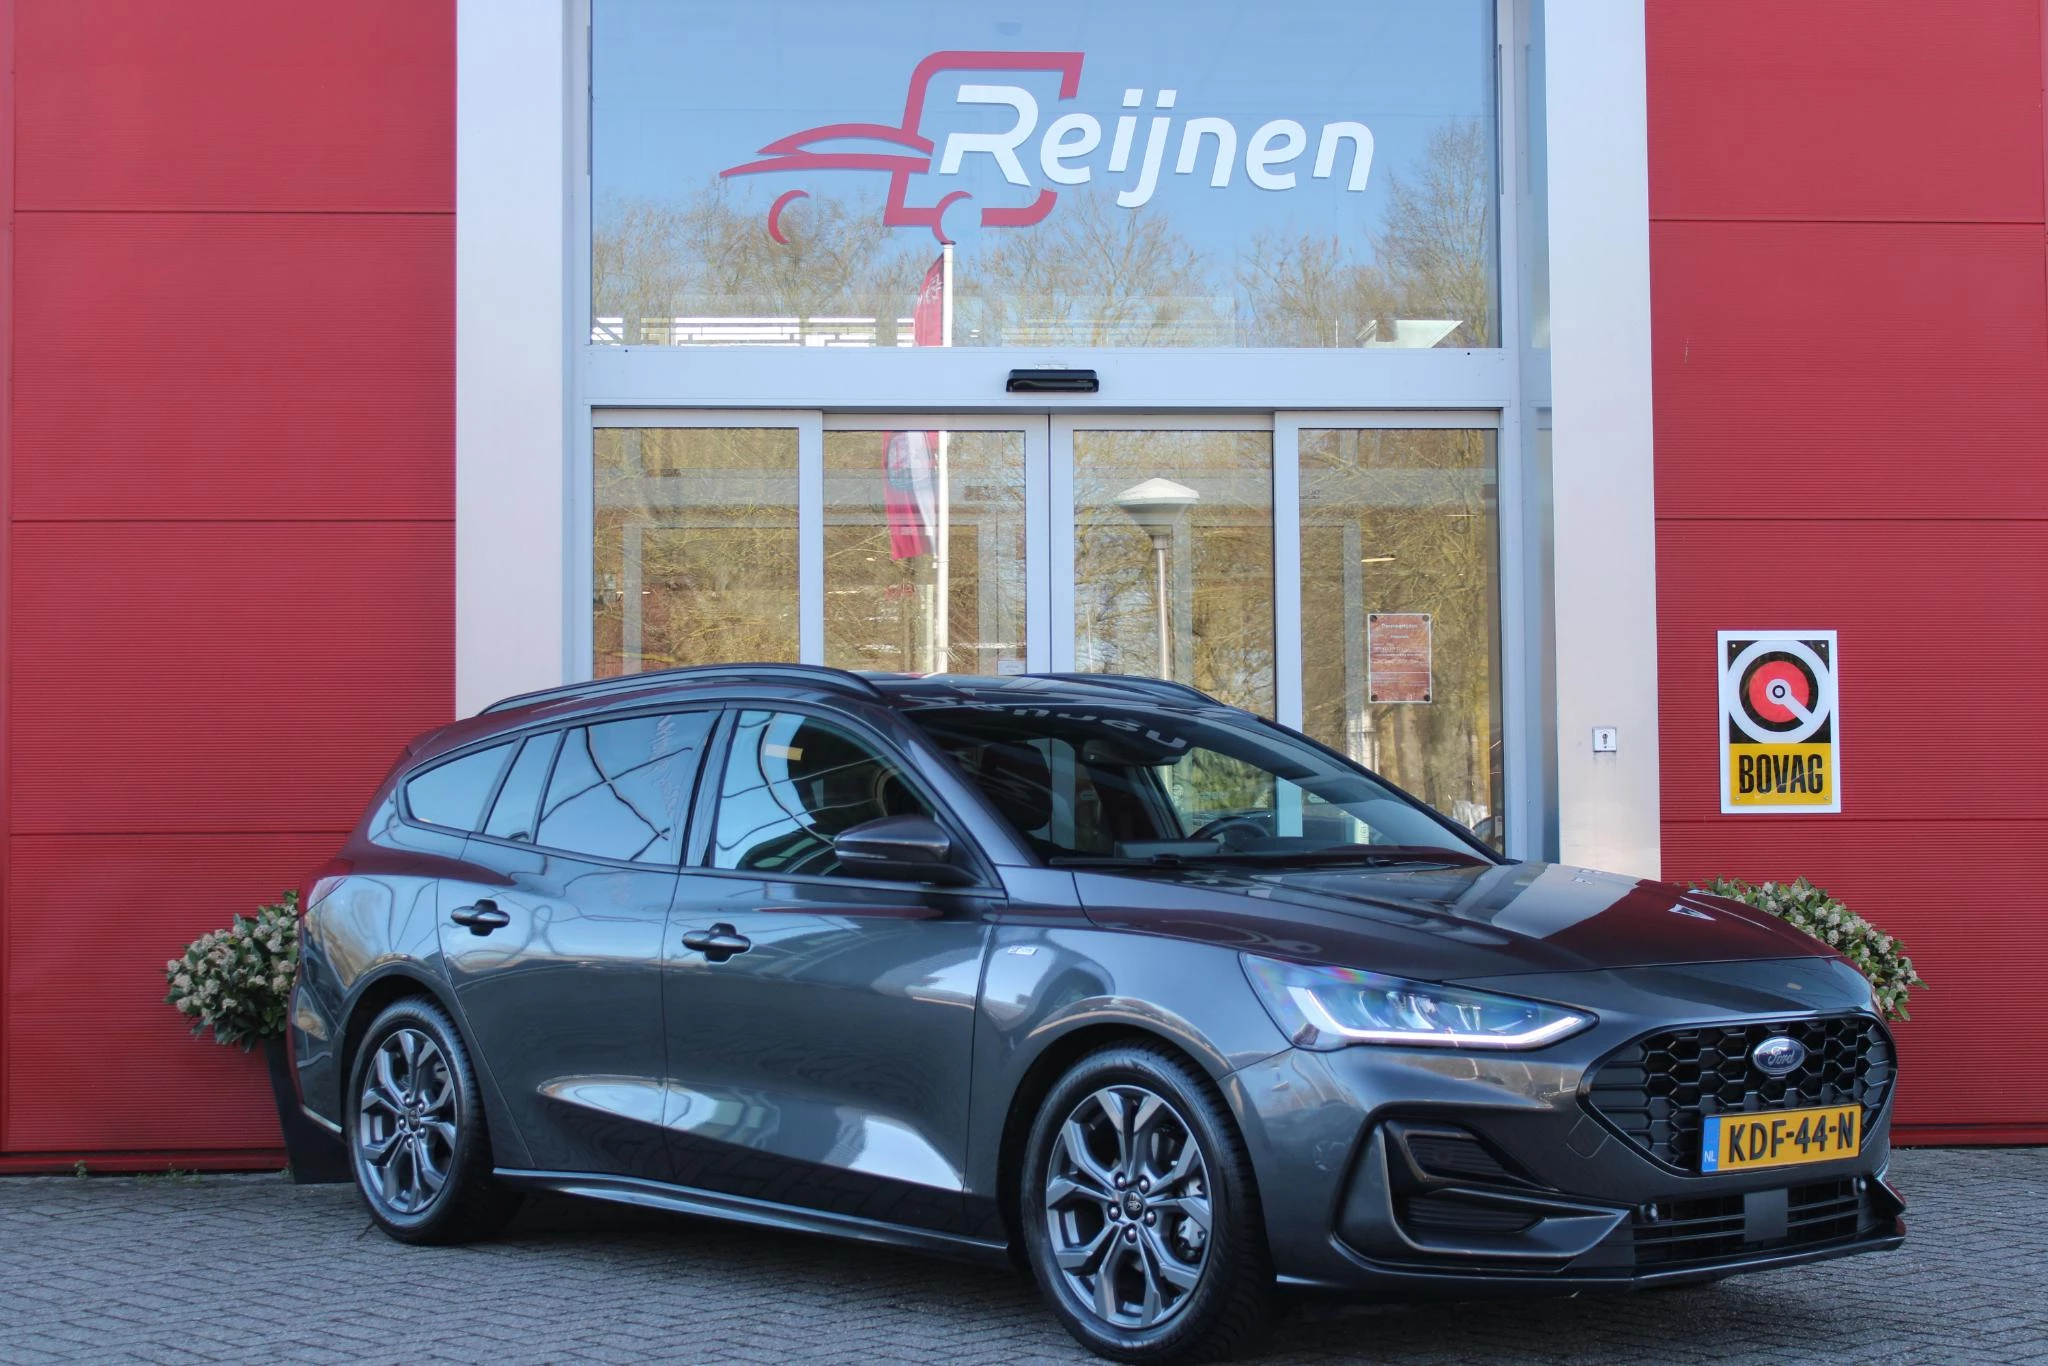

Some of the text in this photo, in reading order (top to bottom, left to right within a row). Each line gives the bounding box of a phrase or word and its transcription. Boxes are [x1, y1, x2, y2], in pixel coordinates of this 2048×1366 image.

[939, 84, 1375, 208] Reijnen
[1738, 753, 1824, 795] BOVAG
[1767, 1046, 1796, 1066] Ford
[1704, 1150, 1717, 1162] NL
[1728, 1111, 1854, 1163] KDF-44-N
